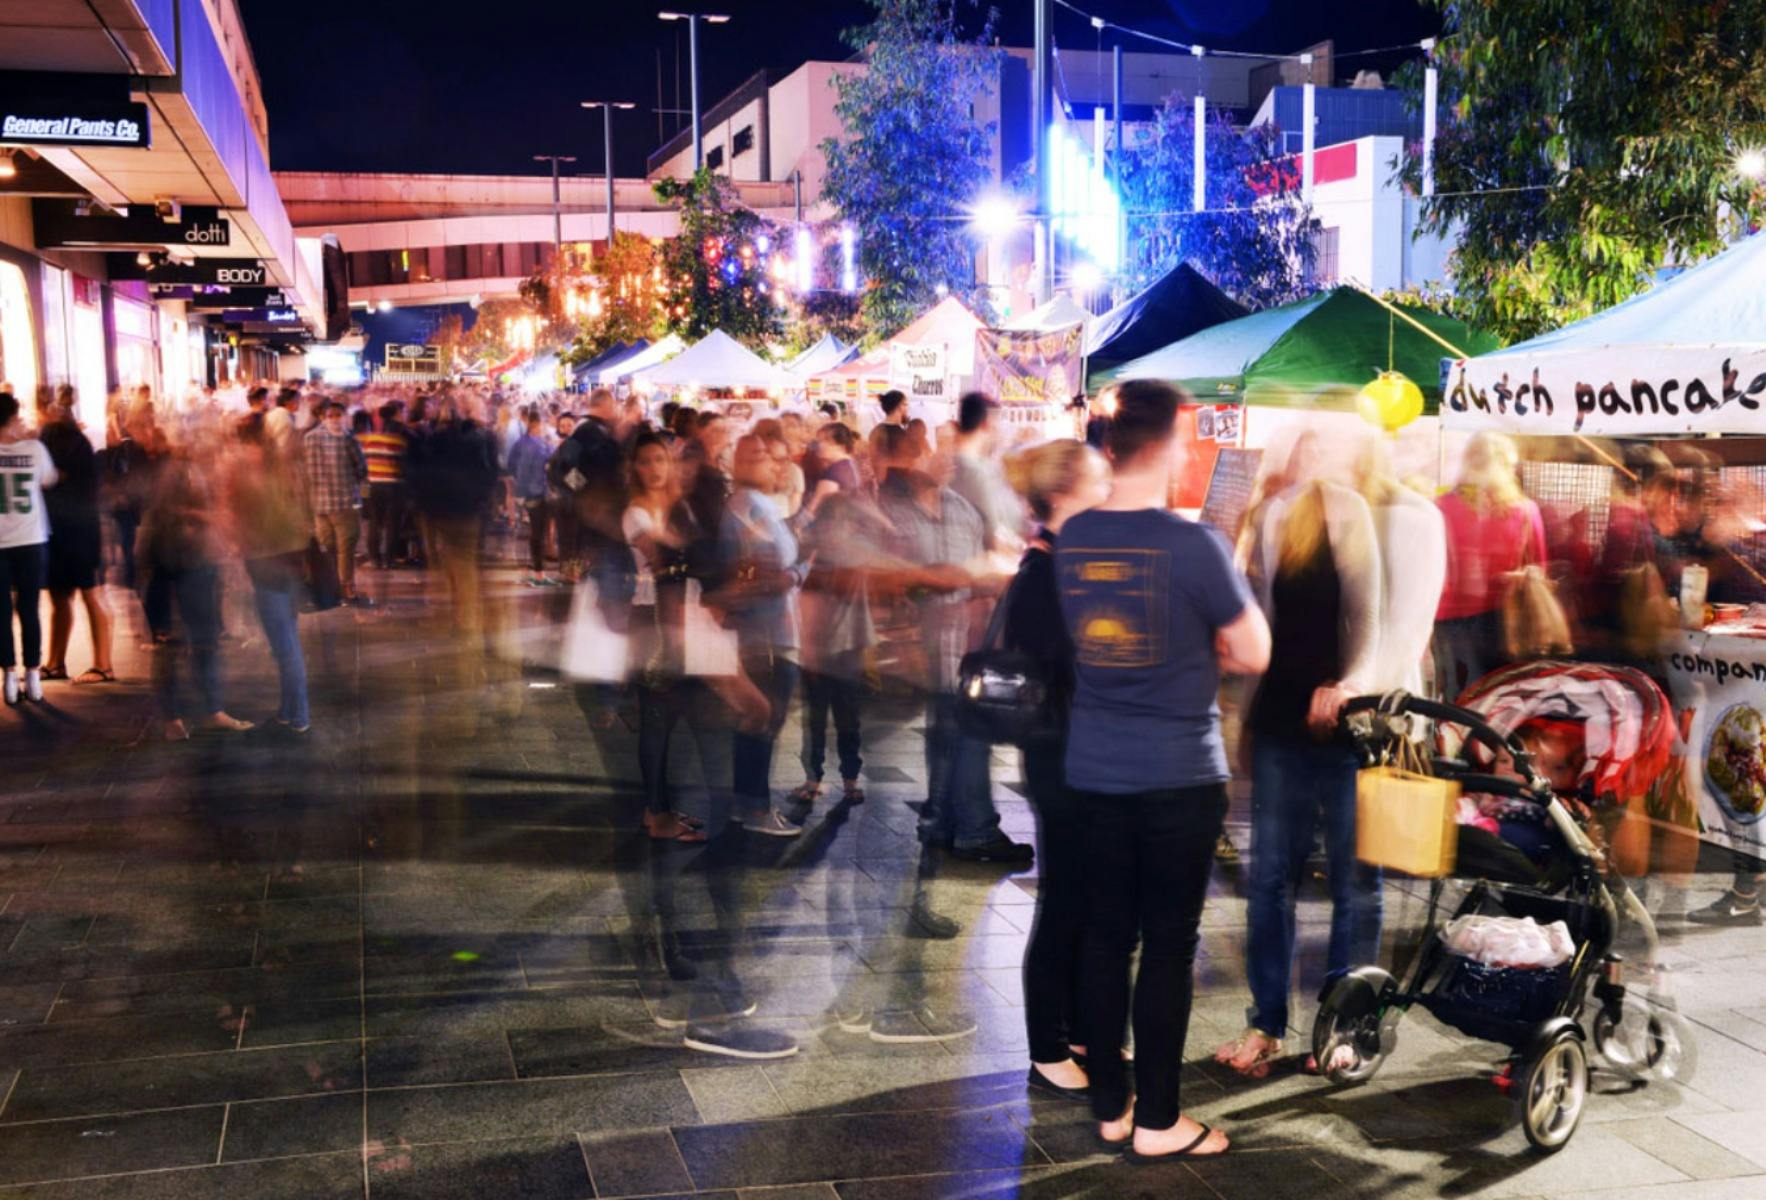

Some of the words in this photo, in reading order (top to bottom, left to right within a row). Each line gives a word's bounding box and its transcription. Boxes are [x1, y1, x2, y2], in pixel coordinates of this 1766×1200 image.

[3, 115, 70, 135] General
[69, 117, 115, 137] Pants
[116, 119, 140, 139] Co.
[184, 222, 227, 242] dotti
[216, 268, 262, 283] BODY
[1450, 367, 1554, 416] dutch
